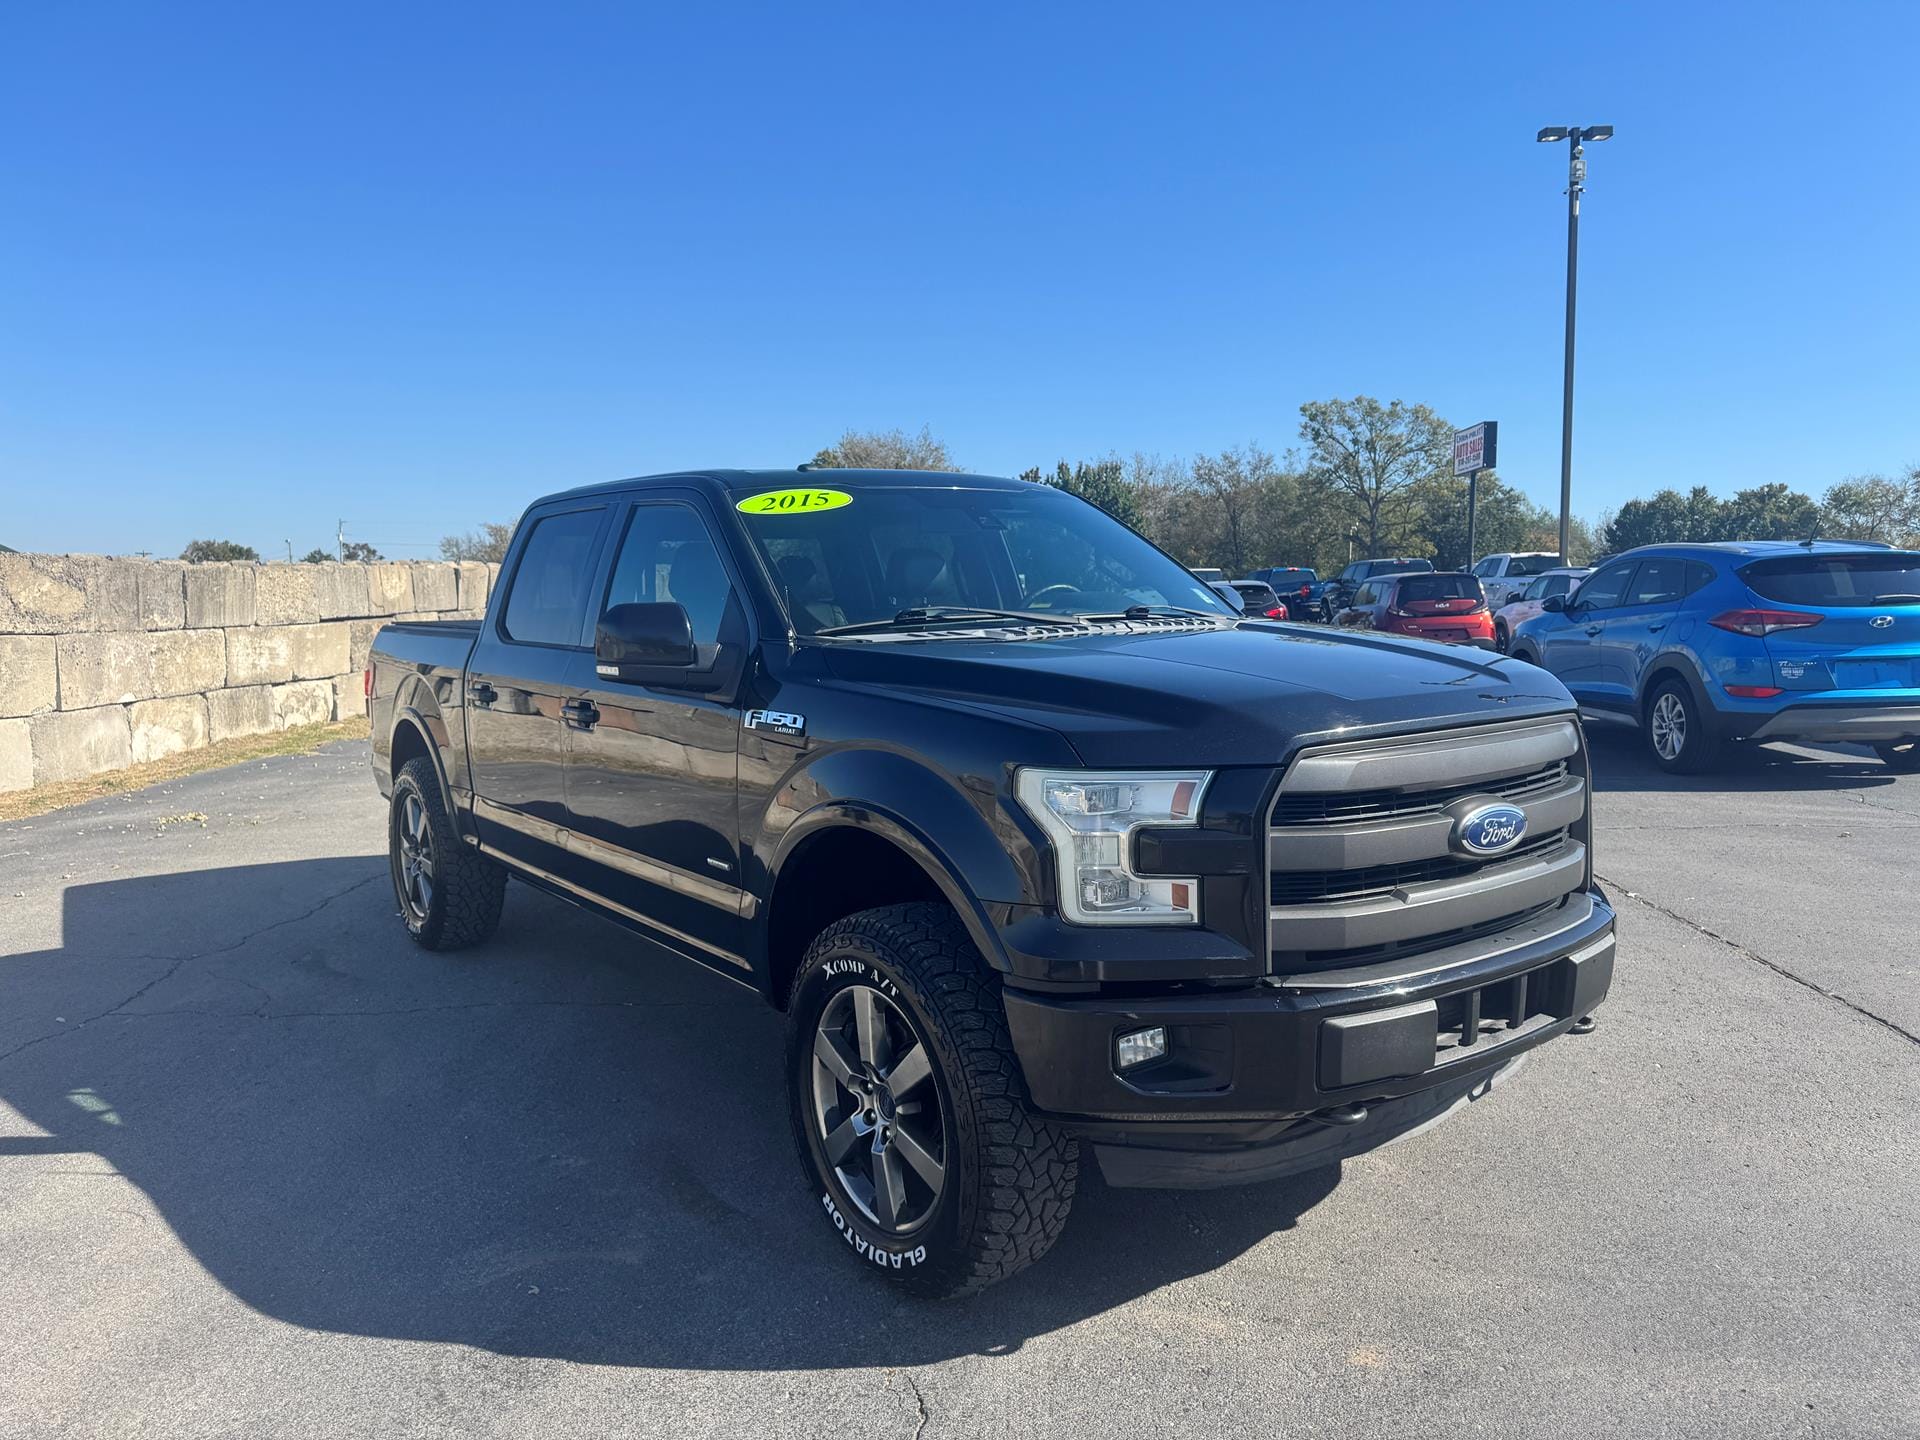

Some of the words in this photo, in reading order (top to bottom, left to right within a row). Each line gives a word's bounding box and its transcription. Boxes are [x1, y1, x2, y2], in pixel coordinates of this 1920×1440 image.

[760, 492, 830, 511] 2015
[774, 725, 796, 735] LARIAT
[1480, 816, 1516, 846] Ford
[822, 959, 865, 981] XCOMP
[822, 1191, 927, 1269] GLADIATOR
